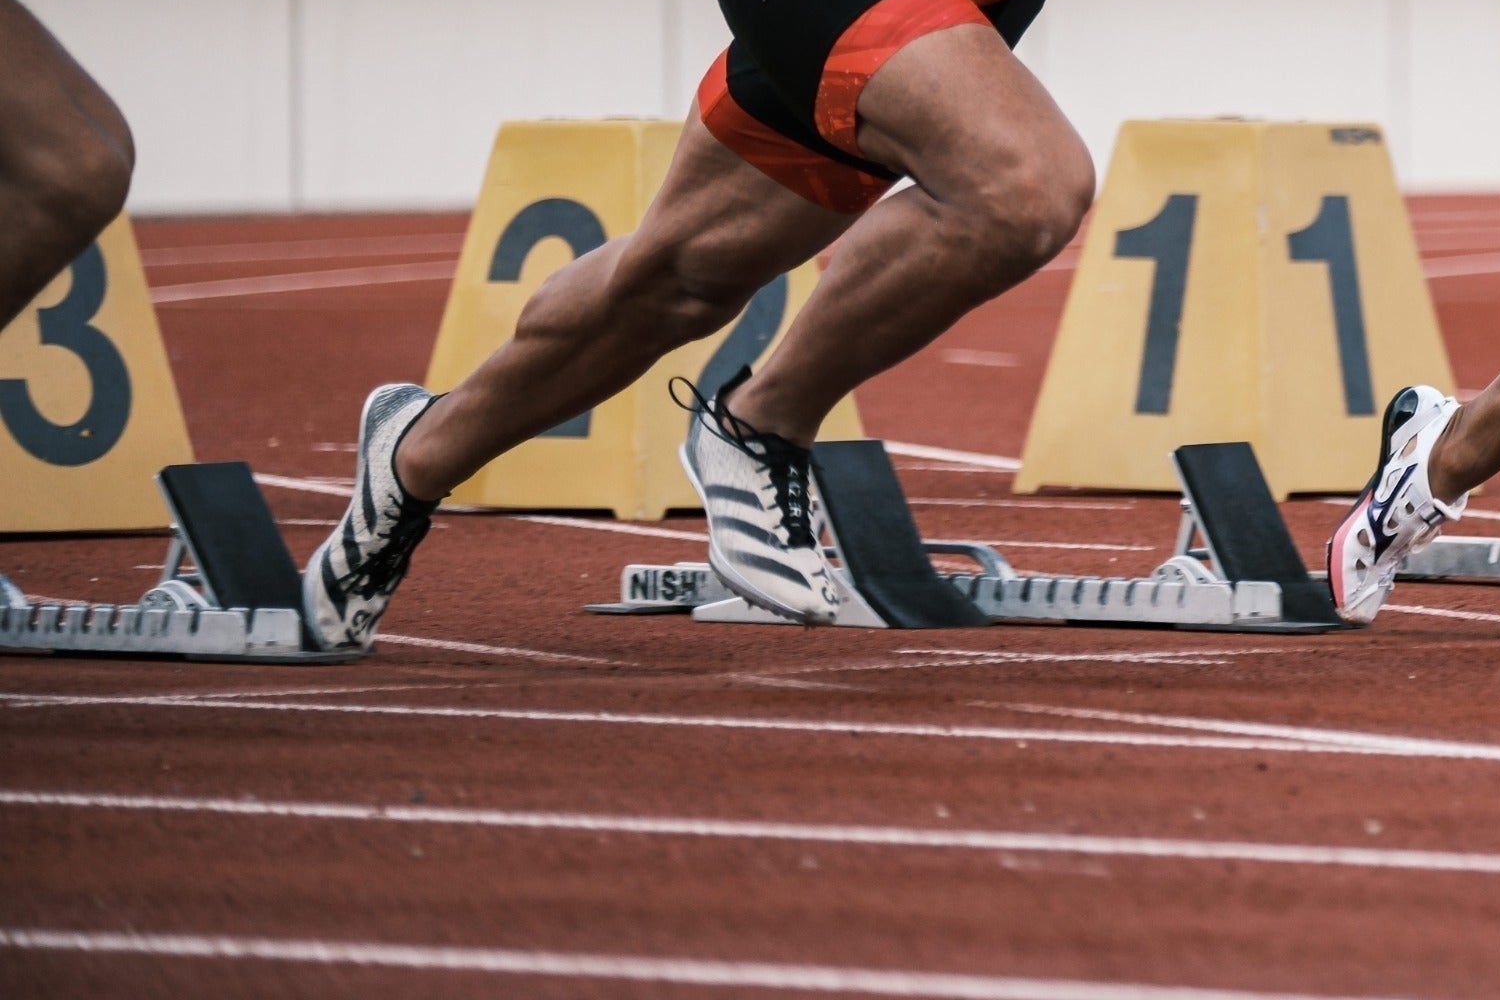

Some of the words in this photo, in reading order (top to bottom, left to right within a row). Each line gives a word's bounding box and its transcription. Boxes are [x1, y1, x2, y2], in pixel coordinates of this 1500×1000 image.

[0, 239, 132, 467] 3
[1112, 194, 1199, 415] 1
[1286, 195, 1376, 417] 1
